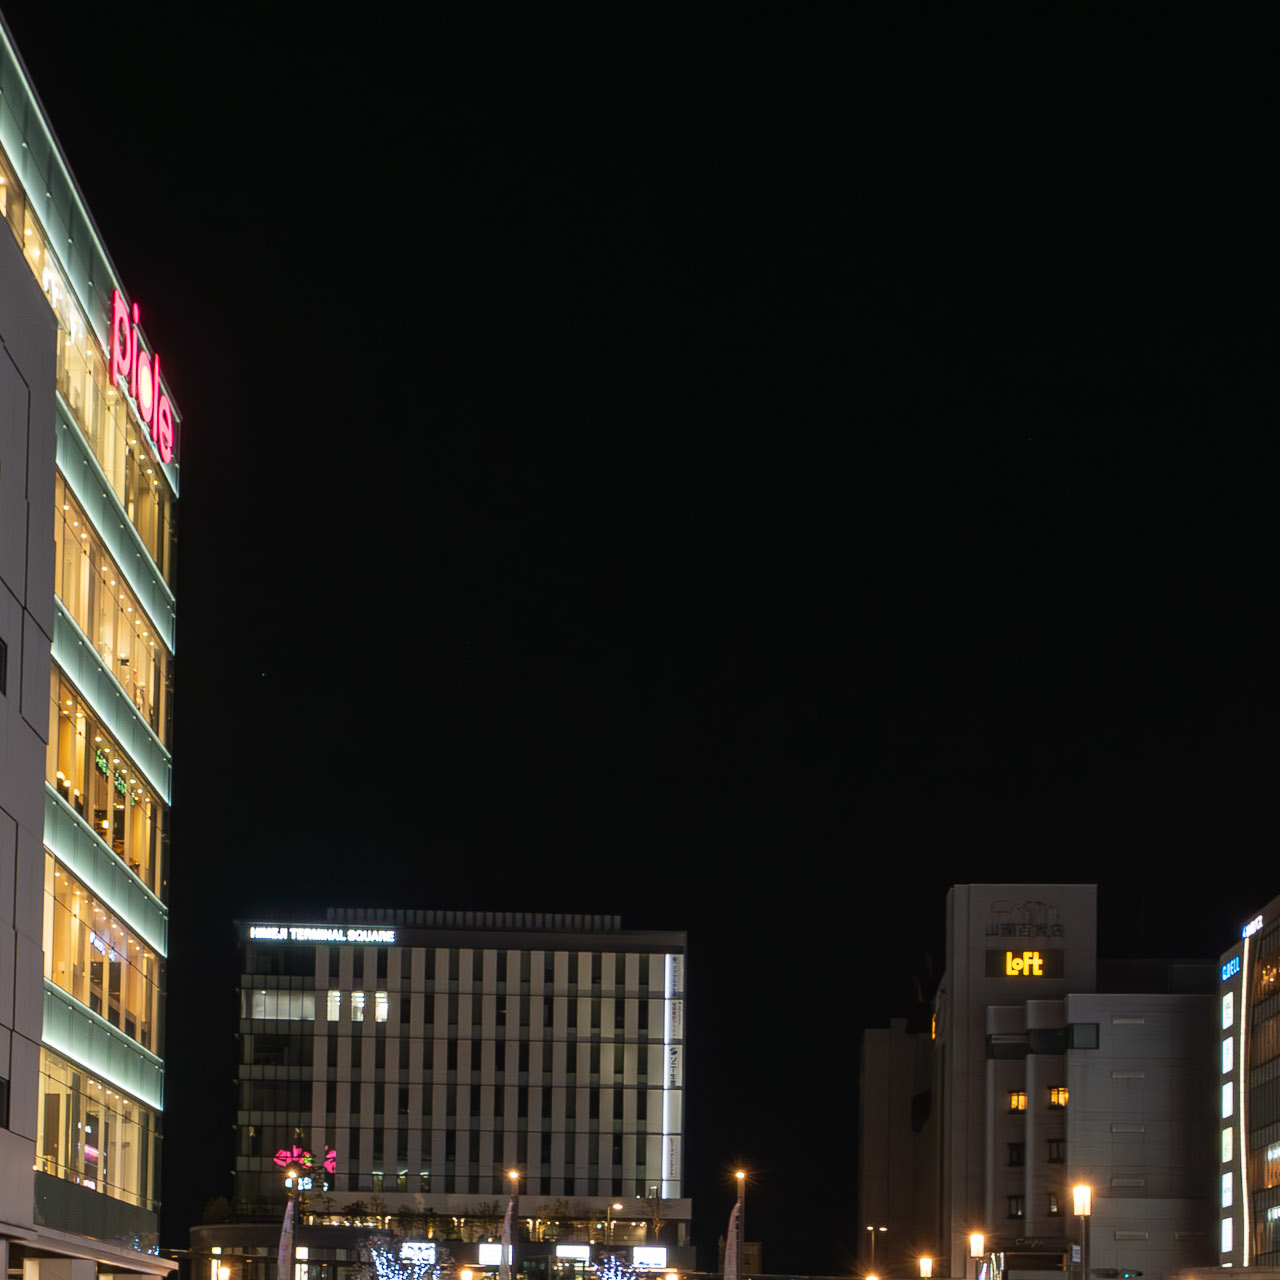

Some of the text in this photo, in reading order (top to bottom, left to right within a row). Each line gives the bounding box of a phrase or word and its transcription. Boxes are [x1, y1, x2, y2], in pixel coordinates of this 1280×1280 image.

[109, 288, 174, 464] piole
[249, 926, 396, 943] HIMEJI TERMINAL SQUARE
